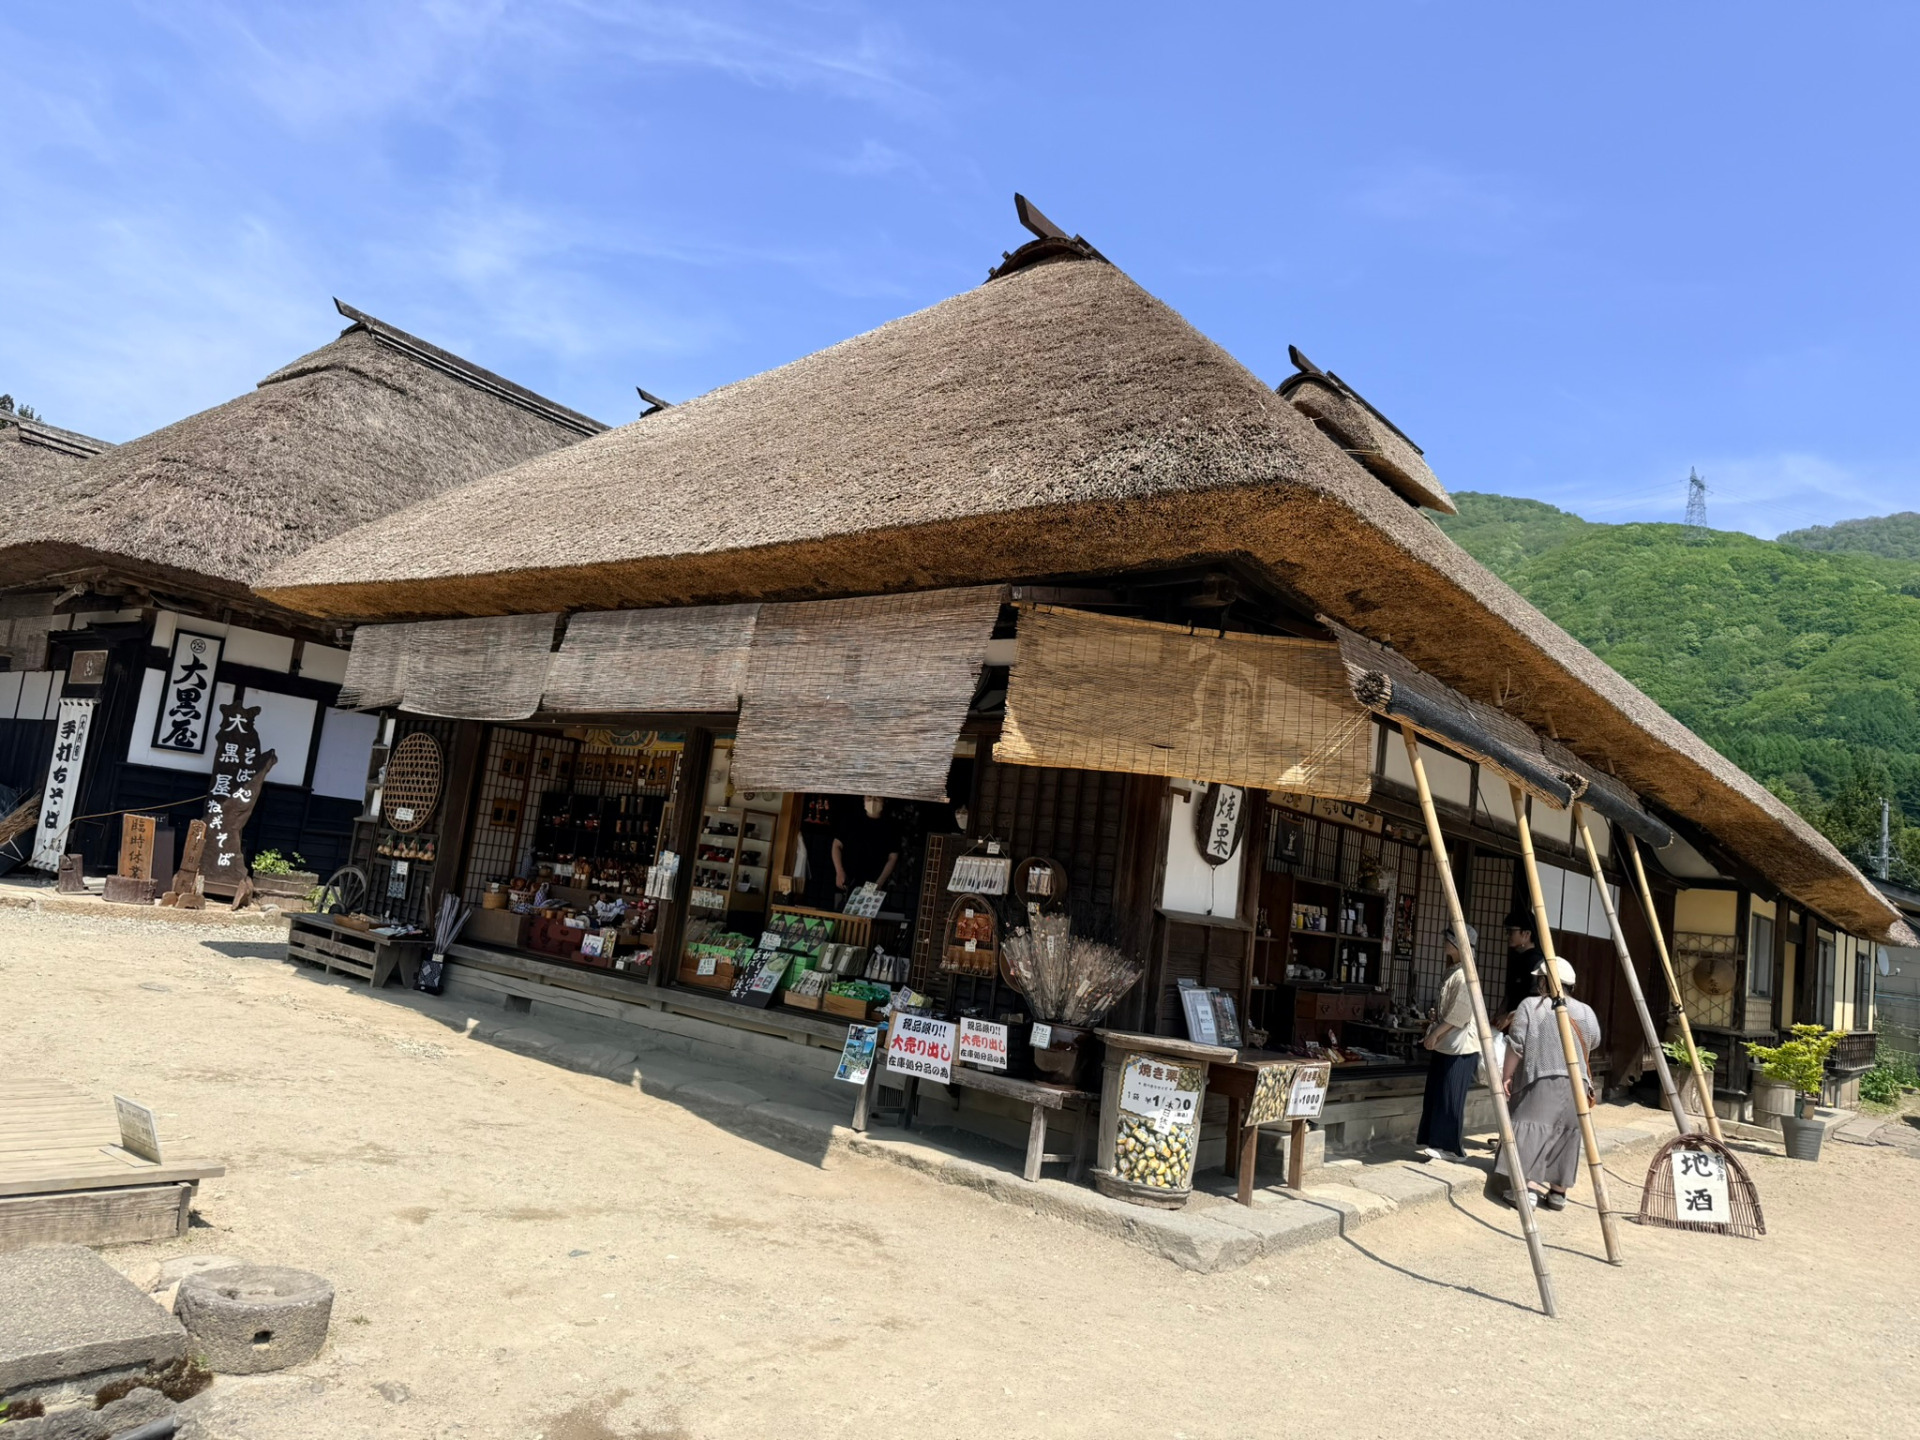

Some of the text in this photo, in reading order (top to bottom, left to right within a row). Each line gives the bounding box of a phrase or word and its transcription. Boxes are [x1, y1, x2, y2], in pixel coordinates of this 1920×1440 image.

[162, 654, 208, 748] 大黒屋
[44, 719, 77, 829] 手打ちそば
[210, 713, 248, 798] 大黒屋
[232, 747, 256, 803] そば処
[128, 818, 147, 879] 臨時休業
[207, 800, 236, 867] ねぎそば
[1213, 790, 1237, 856] 焼栗
[888, 1055, 949, 1079] 在庫処分品の為
[890, 1033, 951, 1062] 大売り出し
[961, 1033, 1006, 1053] 大売り出し
[1138, 1062, 1179, 1083] 焼き栗
[1681, 1153, 1714, 1212] 地酒
